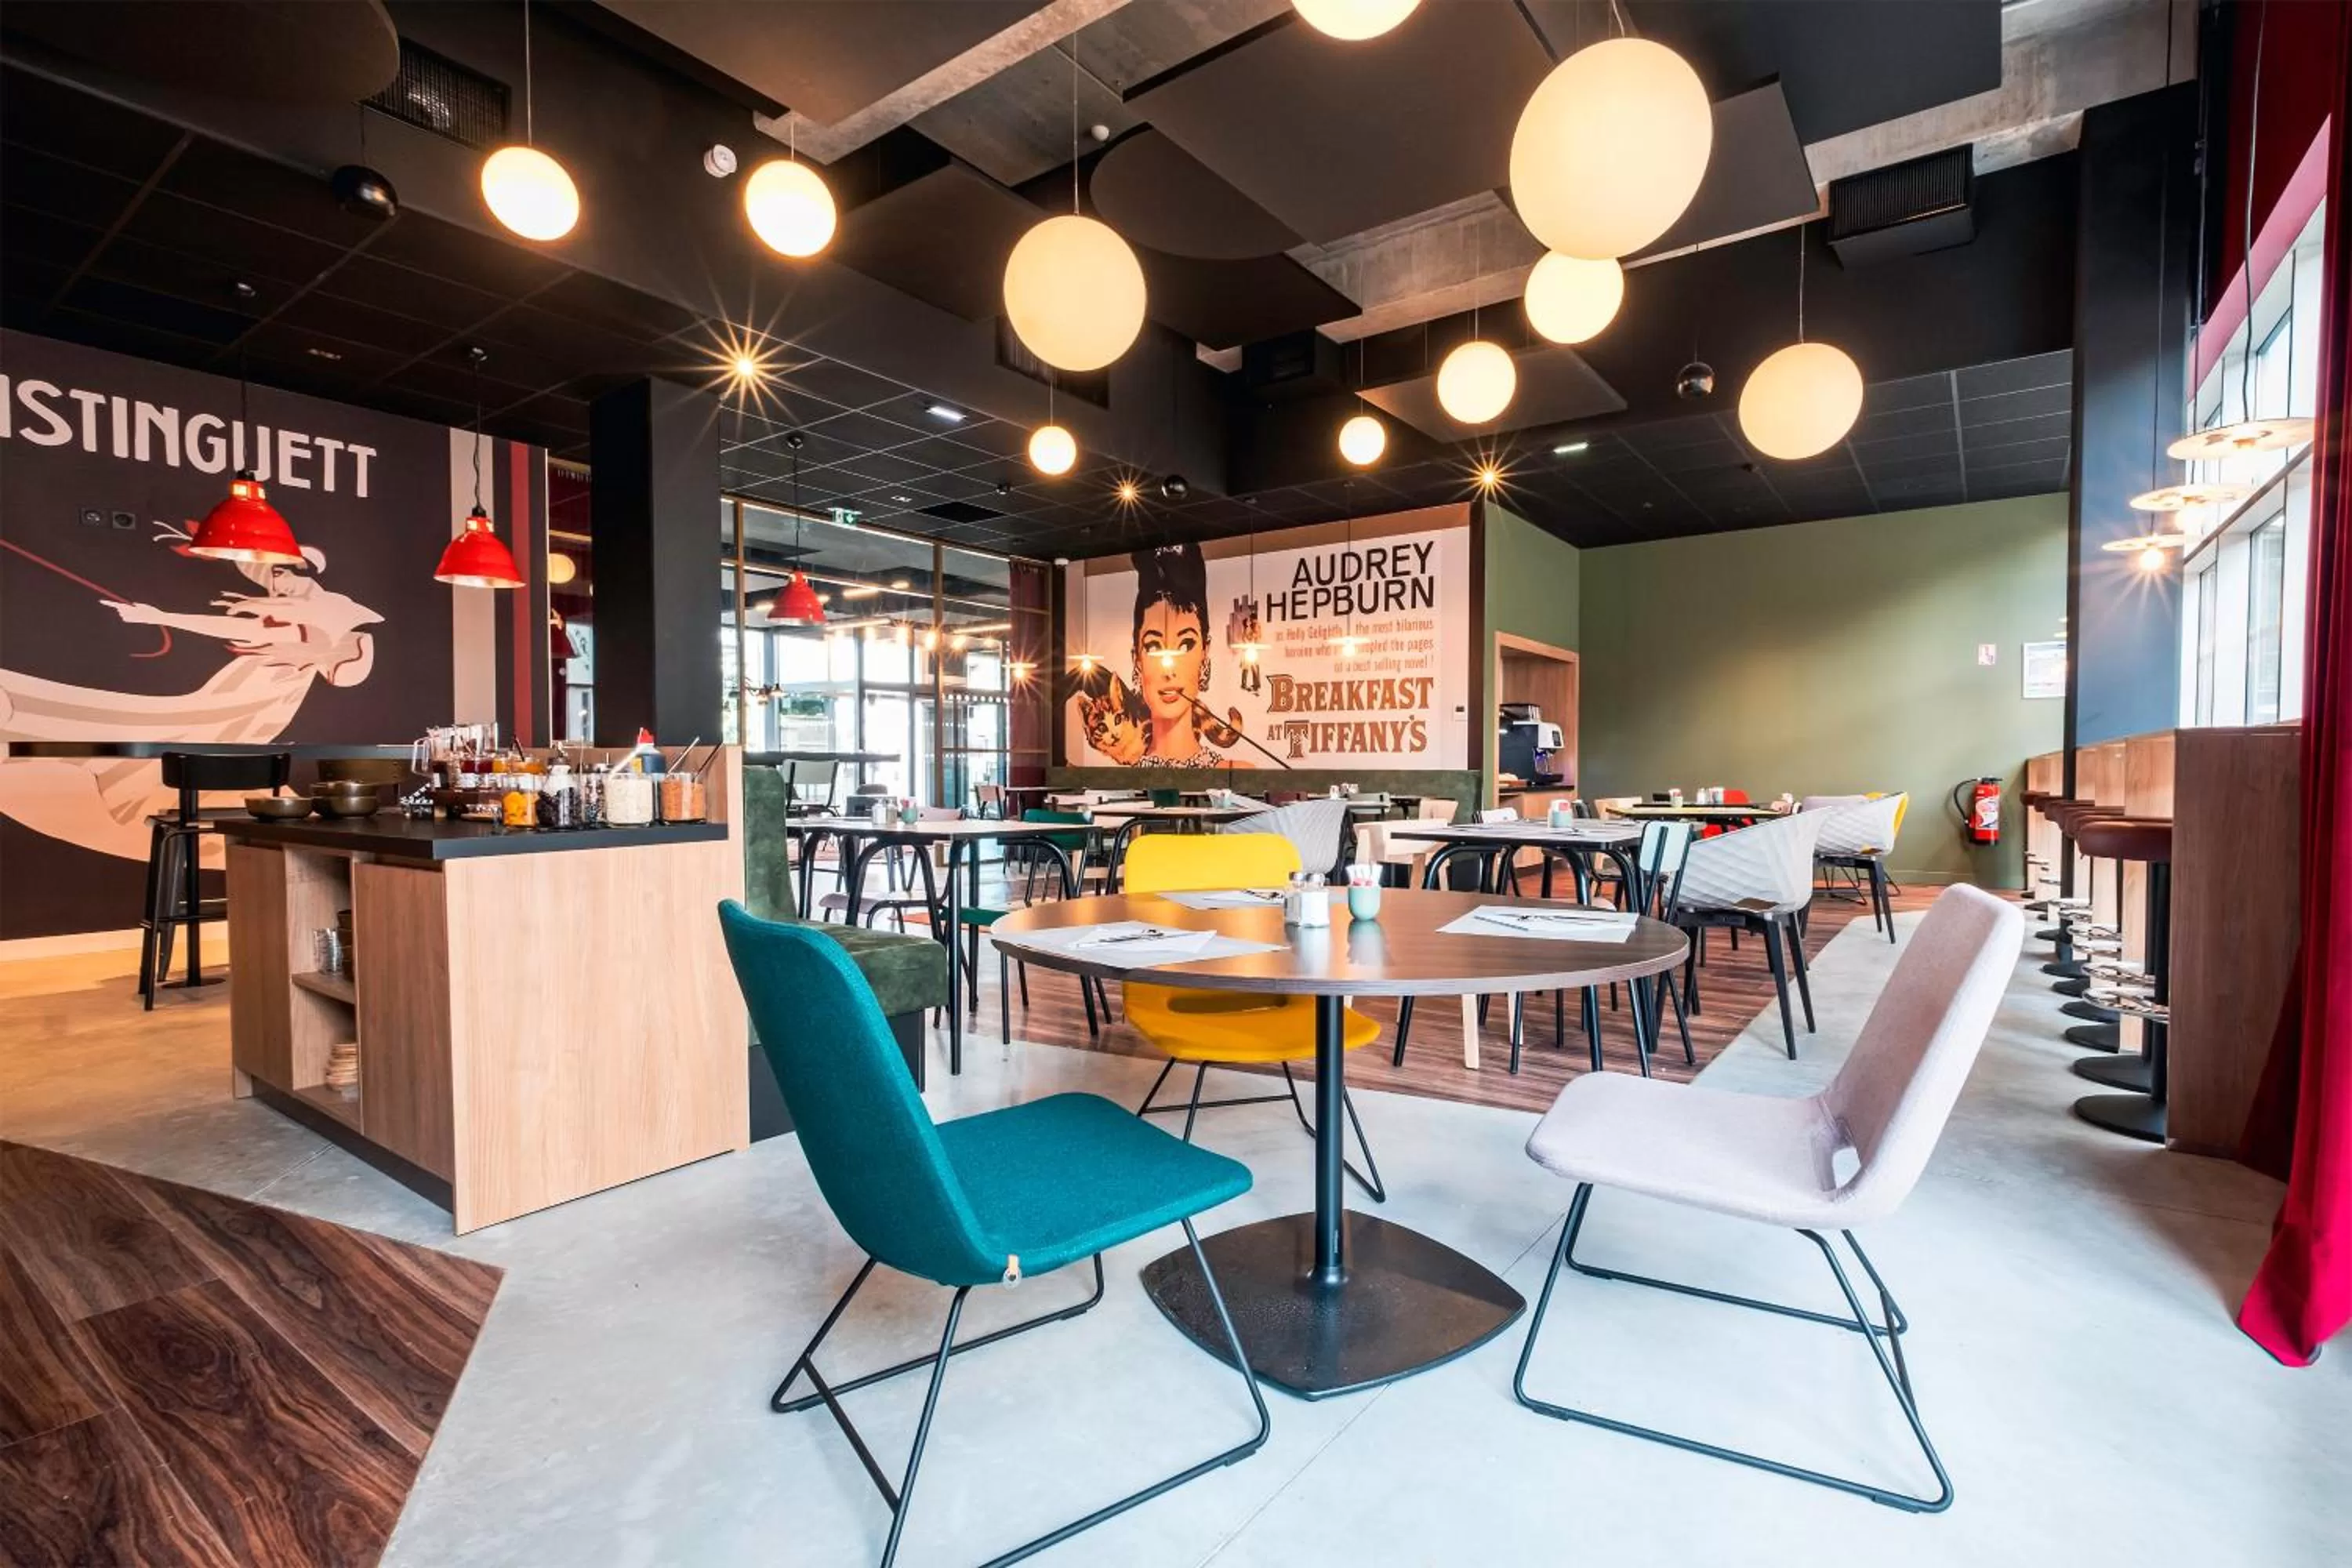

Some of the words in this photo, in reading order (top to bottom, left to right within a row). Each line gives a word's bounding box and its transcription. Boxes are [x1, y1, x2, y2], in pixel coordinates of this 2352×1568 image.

[1292, 541, 1434, 588] AUDREY
[1266, 575, 1434, 622] HEPBURN
[1356, 620, 1369, 633] the
[1372, 620, 1393, 633] most
[1396, 618, 1434, 633] hilarious
[1316, 643, 1331, 656] who
[1391, 639, 1403, 652] the
[1407, 639, 1434, 653] pages
[1266, 674, 1434, 713] BREAKFAST
[1267, 724, 1283, 741] AT
[1284, 714, 1427, 759] TIFFANY'S
